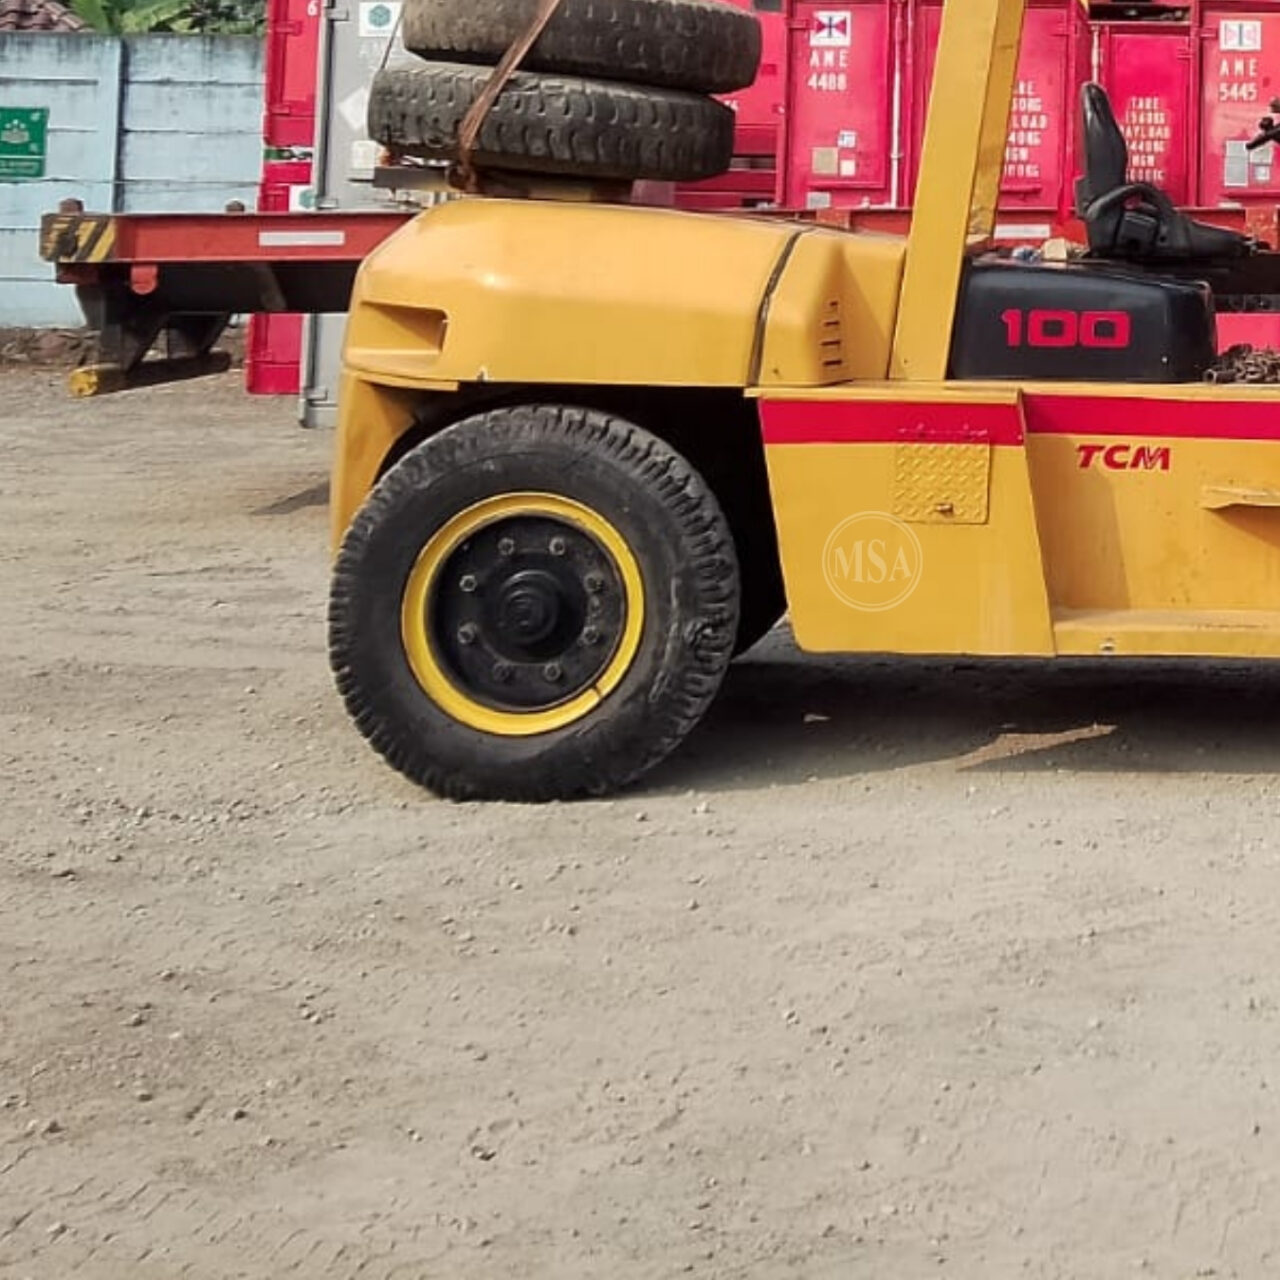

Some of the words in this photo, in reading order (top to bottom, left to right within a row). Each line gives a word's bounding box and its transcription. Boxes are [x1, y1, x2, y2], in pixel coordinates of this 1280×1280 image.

[809, 48, 848, 68] AME
[1219, 59, 1258, 77] AME
[1219, 82, 1257, 101] 5445
[1001, 309, 1131, 347] 100
[1076, 445, 1171, 470] TCM
